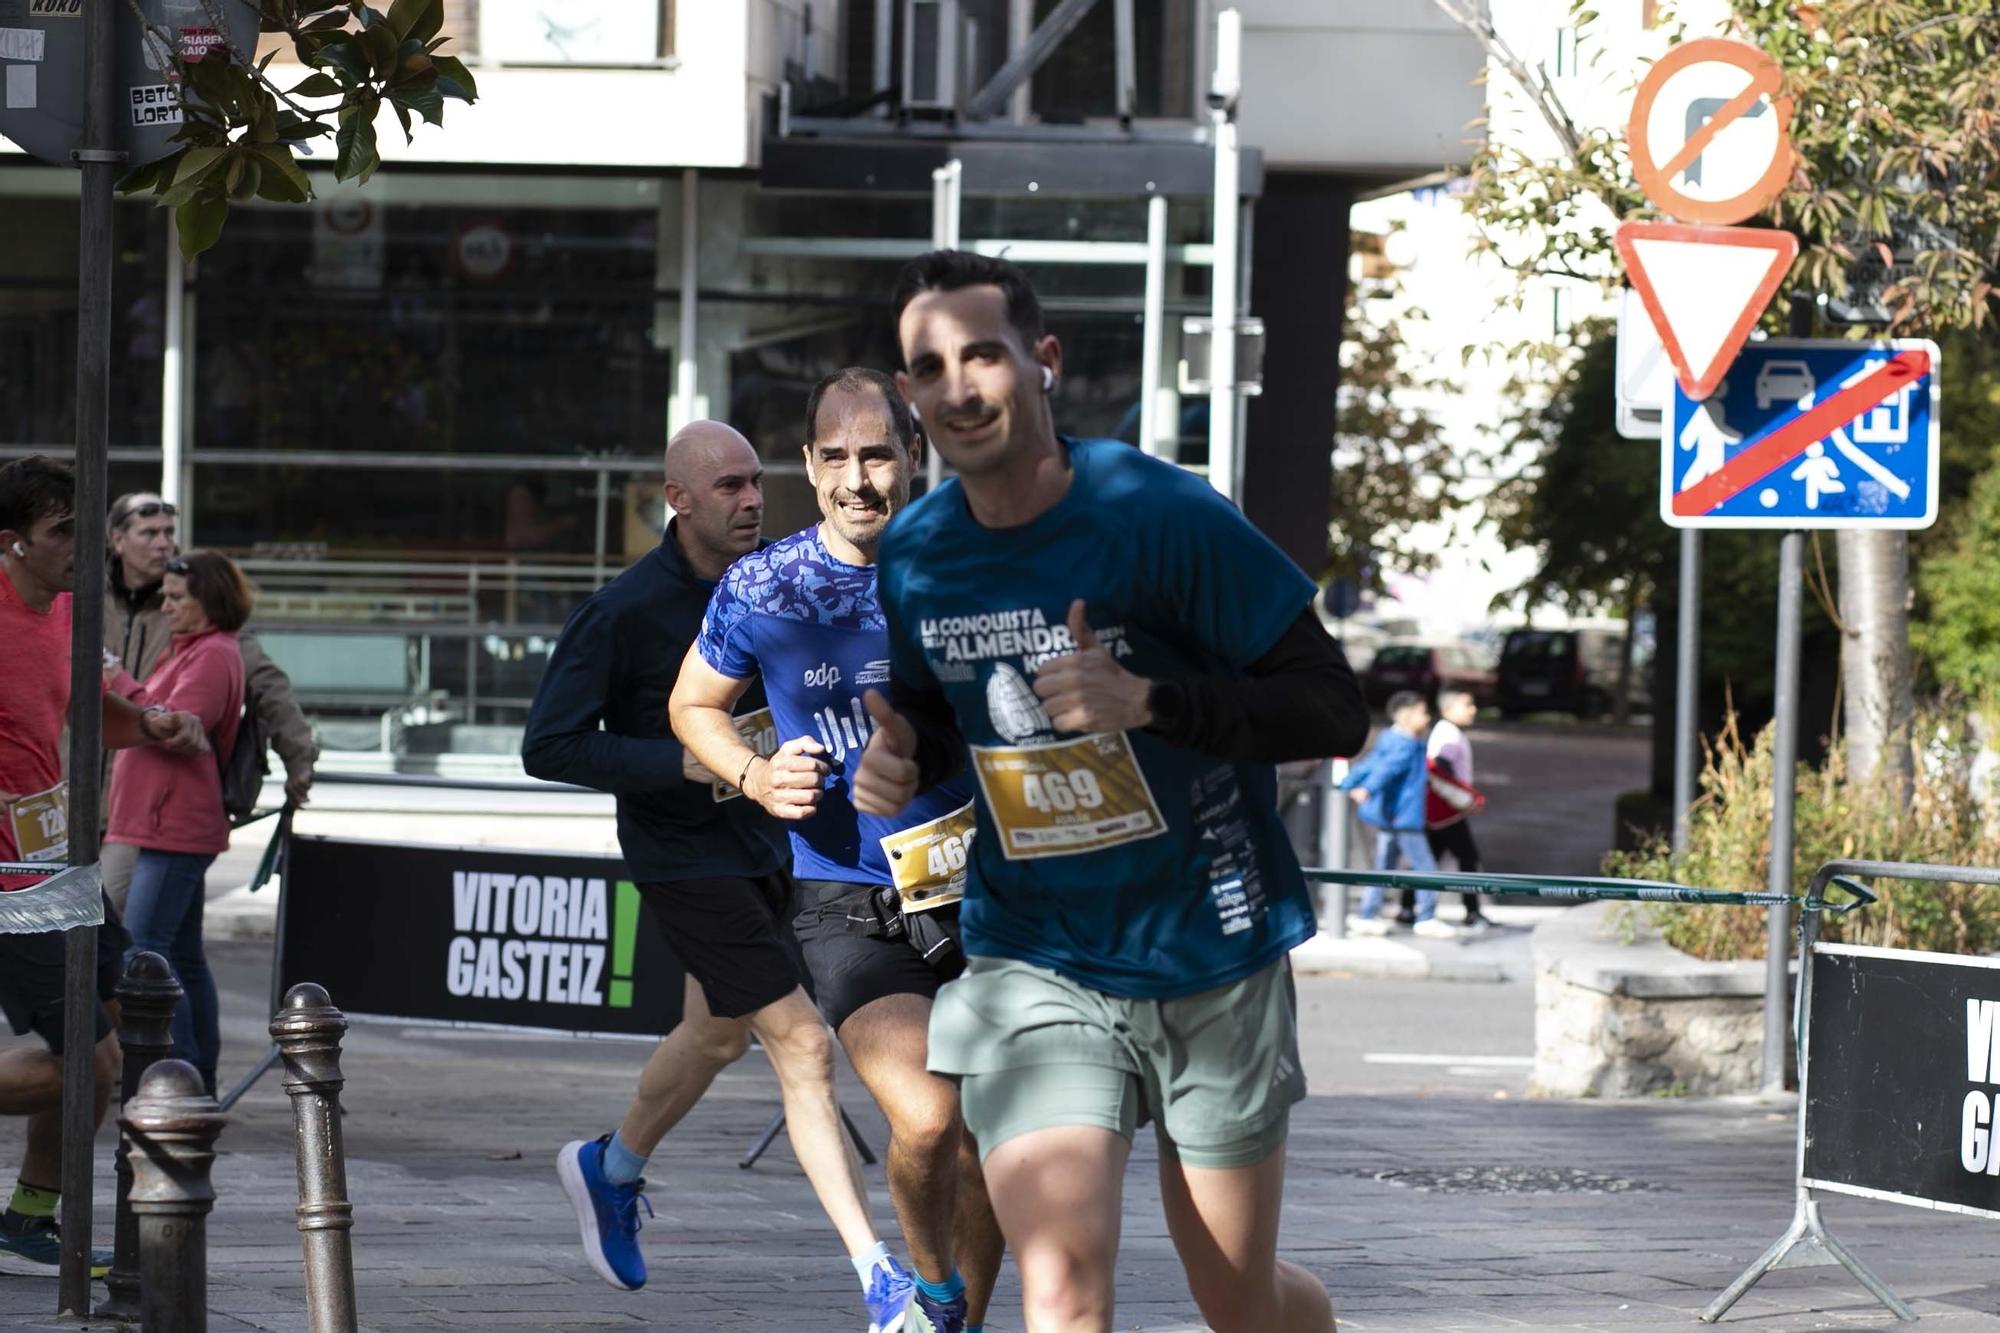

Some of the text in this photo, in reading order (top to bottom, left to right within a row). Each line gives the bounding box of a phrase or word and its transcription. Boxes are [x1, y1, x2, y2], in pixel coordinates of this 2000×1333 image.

[134, 106, 180, 124] LORT
[921, 608, 1046, 637] LA CONQUISTA
[946, 625, 1078, 662] ALMENDR
[804, 662, 841, 690] edp
[1022, 768, 1104, 813] 469
[453, 871, 609, 940] VITORIA
[446, 936, 607, 1006] GASTEIZ
